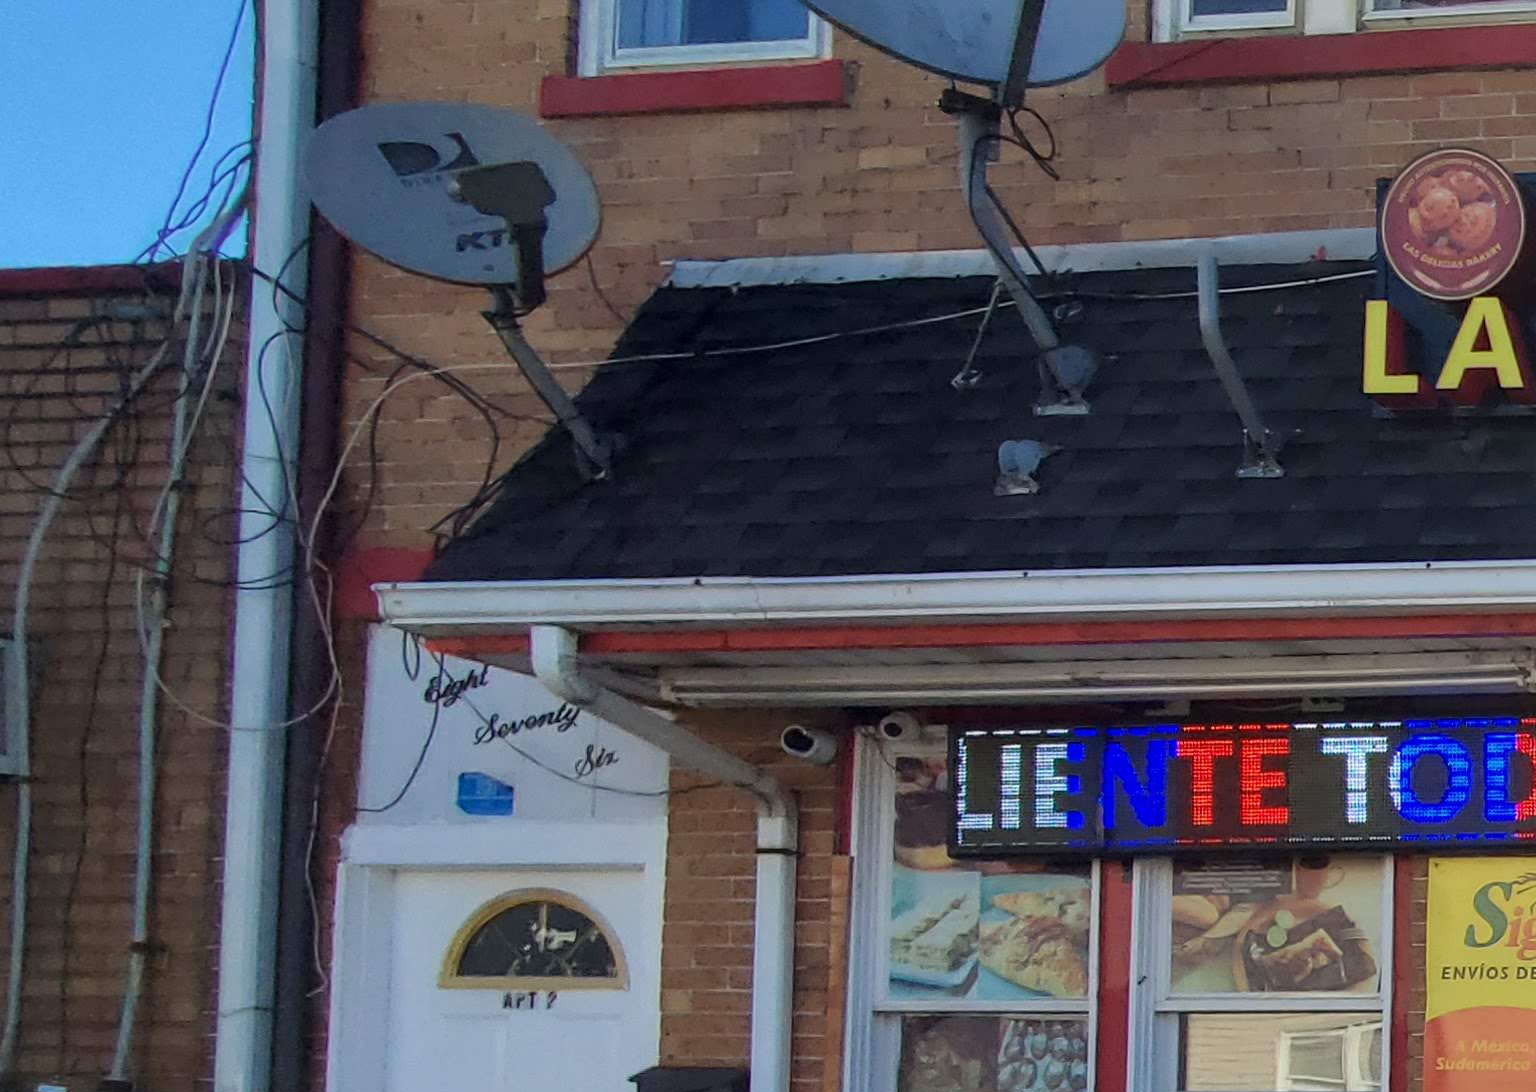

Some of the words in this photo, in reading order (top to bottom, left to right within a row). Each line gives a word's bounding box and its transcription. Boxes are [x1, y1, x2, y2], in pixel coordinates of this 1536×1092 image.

[424, 664, 489, 707] Eight
[473, 703, 581, 745] Seventy
[574, 744, 620, 779] Six
[1441, 962, 1509, 980] ENVÍOS
[502, 991, 539, 1010] APT
